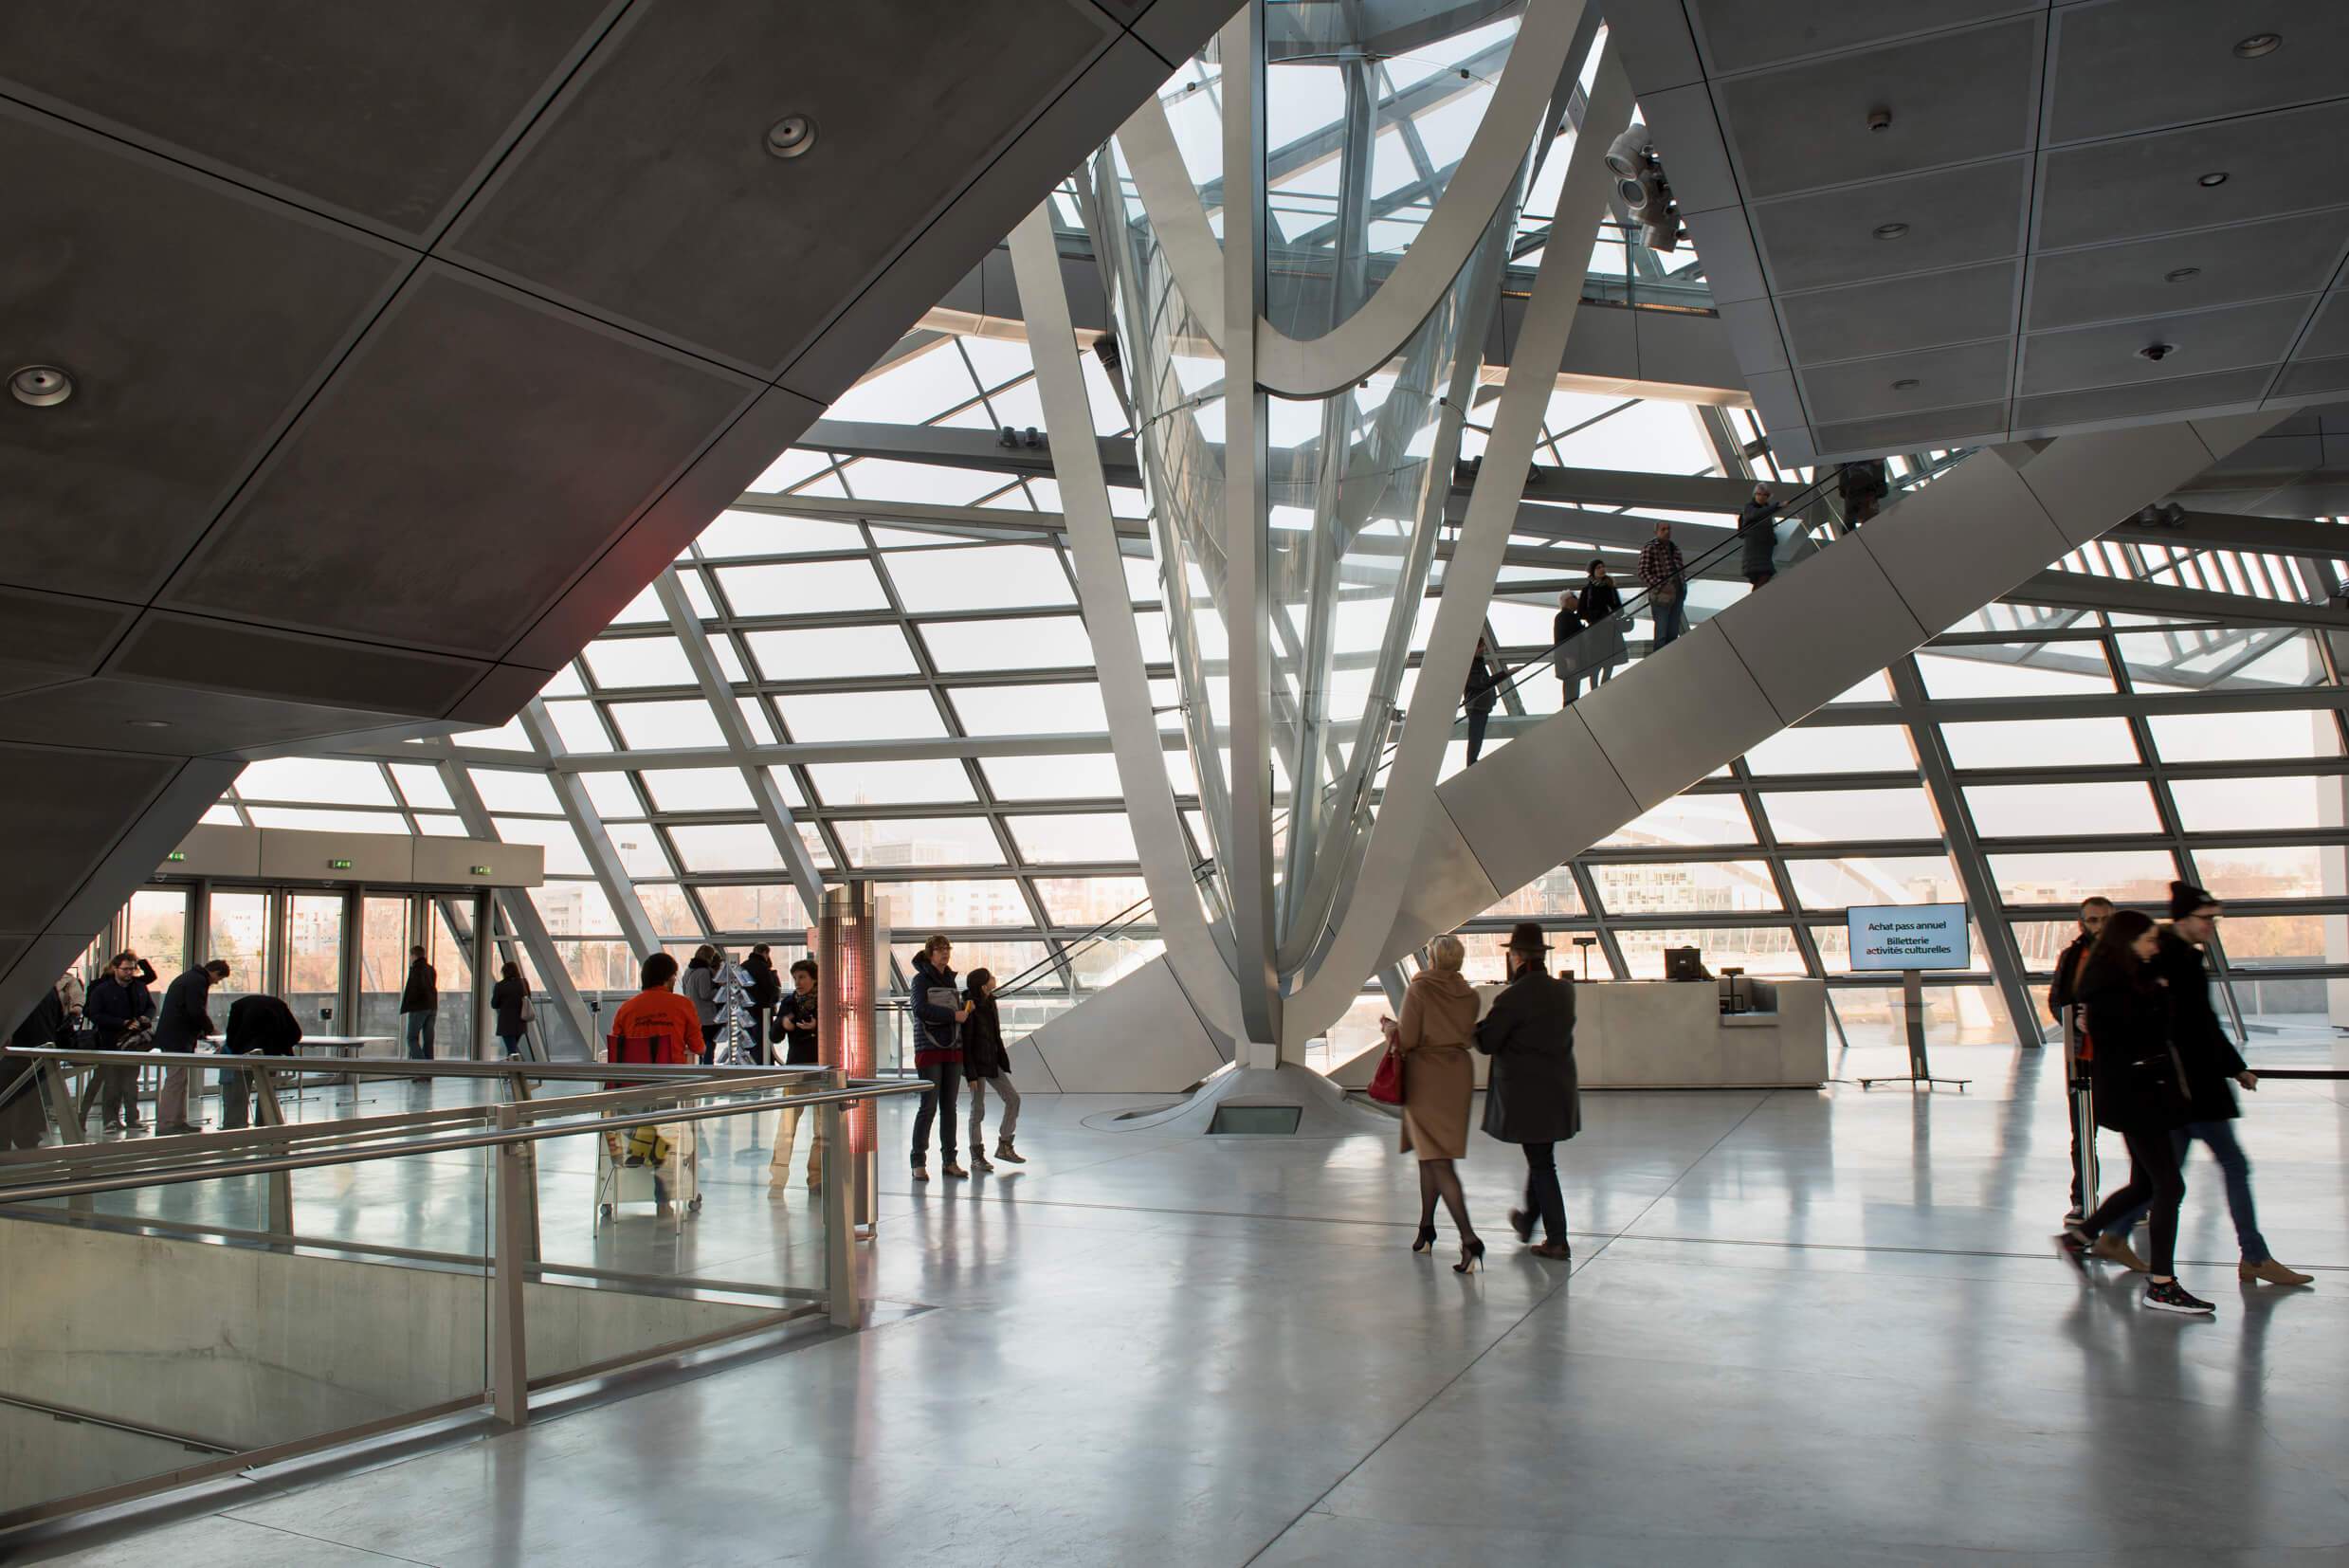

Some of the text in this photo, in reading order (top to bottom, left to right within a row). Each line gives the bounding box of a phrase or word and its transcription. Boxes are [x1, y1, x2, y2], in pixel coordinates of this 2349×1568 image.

[1868, 921, 1947, 932] Achat pass annuel
[1886, 936, 1930, 945] Billetterie
[1866, 945, 1952, 955] activités culturelles
